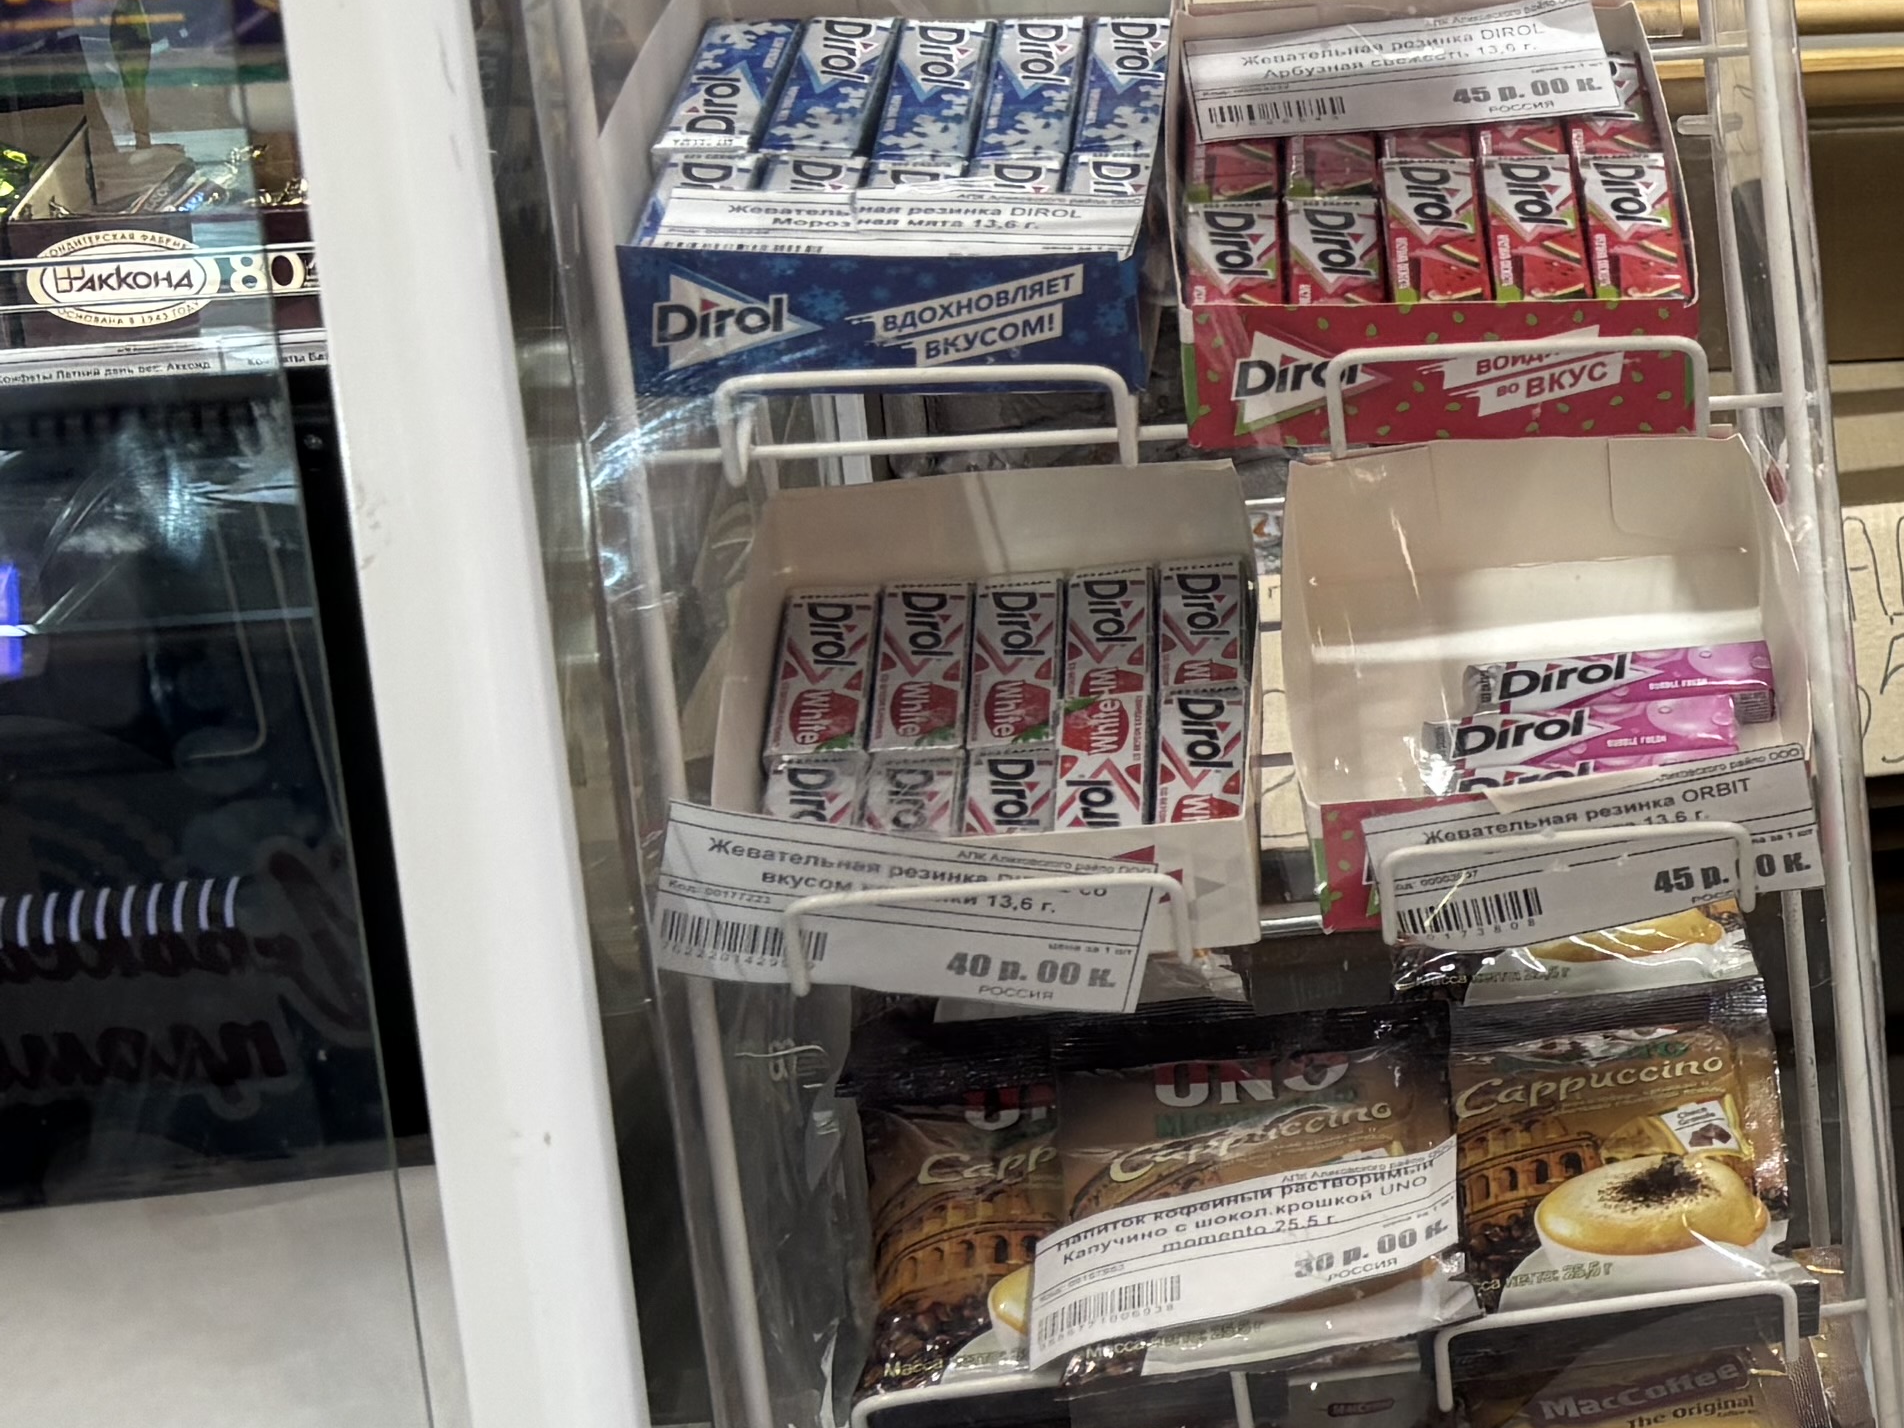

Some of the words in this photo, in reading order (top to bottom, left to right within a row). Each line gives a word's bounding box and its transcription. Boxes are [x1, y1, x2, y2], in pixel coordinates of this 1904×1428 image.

[820, 21, 874, 83] Dirol
[918, 25, 968, 89] Dirol
[1016, 22, 1070, 85] Dirol
[1111, 21, 1163, 80] Dirol
[1480, 22, 1546, 41] DIROL
[1263, 60, 1364, 80] Арбузная
[1452, 86, 1492, 104] 45
[1530, 77, 1570, 97] 00
[686, 74, 742, 135] Dirol
[1488, 100, 1555, 114] РОССИЯ
[907, 206, 1002, 217] резинка
[1009, 206, 1082, 219] DIROL
[1401, 166, 1469, 231] Dirol
[1500, 162, 1569, 226] Dirol
[1597, 162, 1664, 226] Dirol
[973, 218, 1017, 230] 13,6
[1203, 209, 1271, 278] Dirol
[1303, 208, 1373, 278] Dirol
[229, 252, 306, 294] 80
[656, 296, 785, 344] Dirol
[882, 272, 1076, 334] ВДОХНОВЛЯЕТ
[925, 312, 1055, 361] ВКУСОМ!
[1525, 360, 1608, 399] ВКУС
[902, 591, 954, 656] Dirol
[993, 591, 1046, 656] Dirol
[1084, 579, 1137, 644] Dirol
[1176, 572, 1230, 636] Dirol
[807, 602, 858, 667] Dirol
[1498, 652, 1627, 701] Dirol
[797, 689, 833, 745] White
[899, 681, 933, 739] White
[991, 680, 1026, 739] White
[1177, 696, 1234, 769] Dirol
[1452, 708, 1585, 760] Dirol
[987, 758, 1040, 829] Dirol
[1423, 809, 1578, 844] Жевательная
[1585, 796, 1676, 822] резинка
[1681, 777, 1752, 803] ORBIT
[707, 836, 881, 874] Жевательная
[888, 864, 988, 883] резинка
[761, 871, 852, 892] вкусом
[1653, 866, 1695, 894] 45
[1700, 864, 1730, 889] р.
[1783, 851, 1812, 874] к.
[987, 893, 1033, 913] 13,6
[946, 951, 992, 978] 40
[997, 960, 1027, 982] р.
[1036, 959, 1081, 986] 00
[1087, 967, 1116, 988] к.
[978, 984, 1054, 1001] РОССИЯ
[1154, 1052, 1350, 1108] UNO
[1455, 1053, 1725, 1119] Cappuccino
[1062, 1227, 1167, 1265] Капучино
[1175, 1223, 1187, 1233] с
[1380, 1174, 1428, 1197] UNO
[1161, 1221, 1267, 1254] momento
[1294, 1251, 1335, 1279] 30
[1342, 1245, 1369, 1266] р.
[1377, 1228, 1418, 1255] 00
[1424, 1218, 1449, 1241] к.
[1327, 1256, 1398, 1282] РОССИЯ
[1539, 1362, 1741, 1423] MacCoffee
[1672, 1394, 1756, 1421] Original
